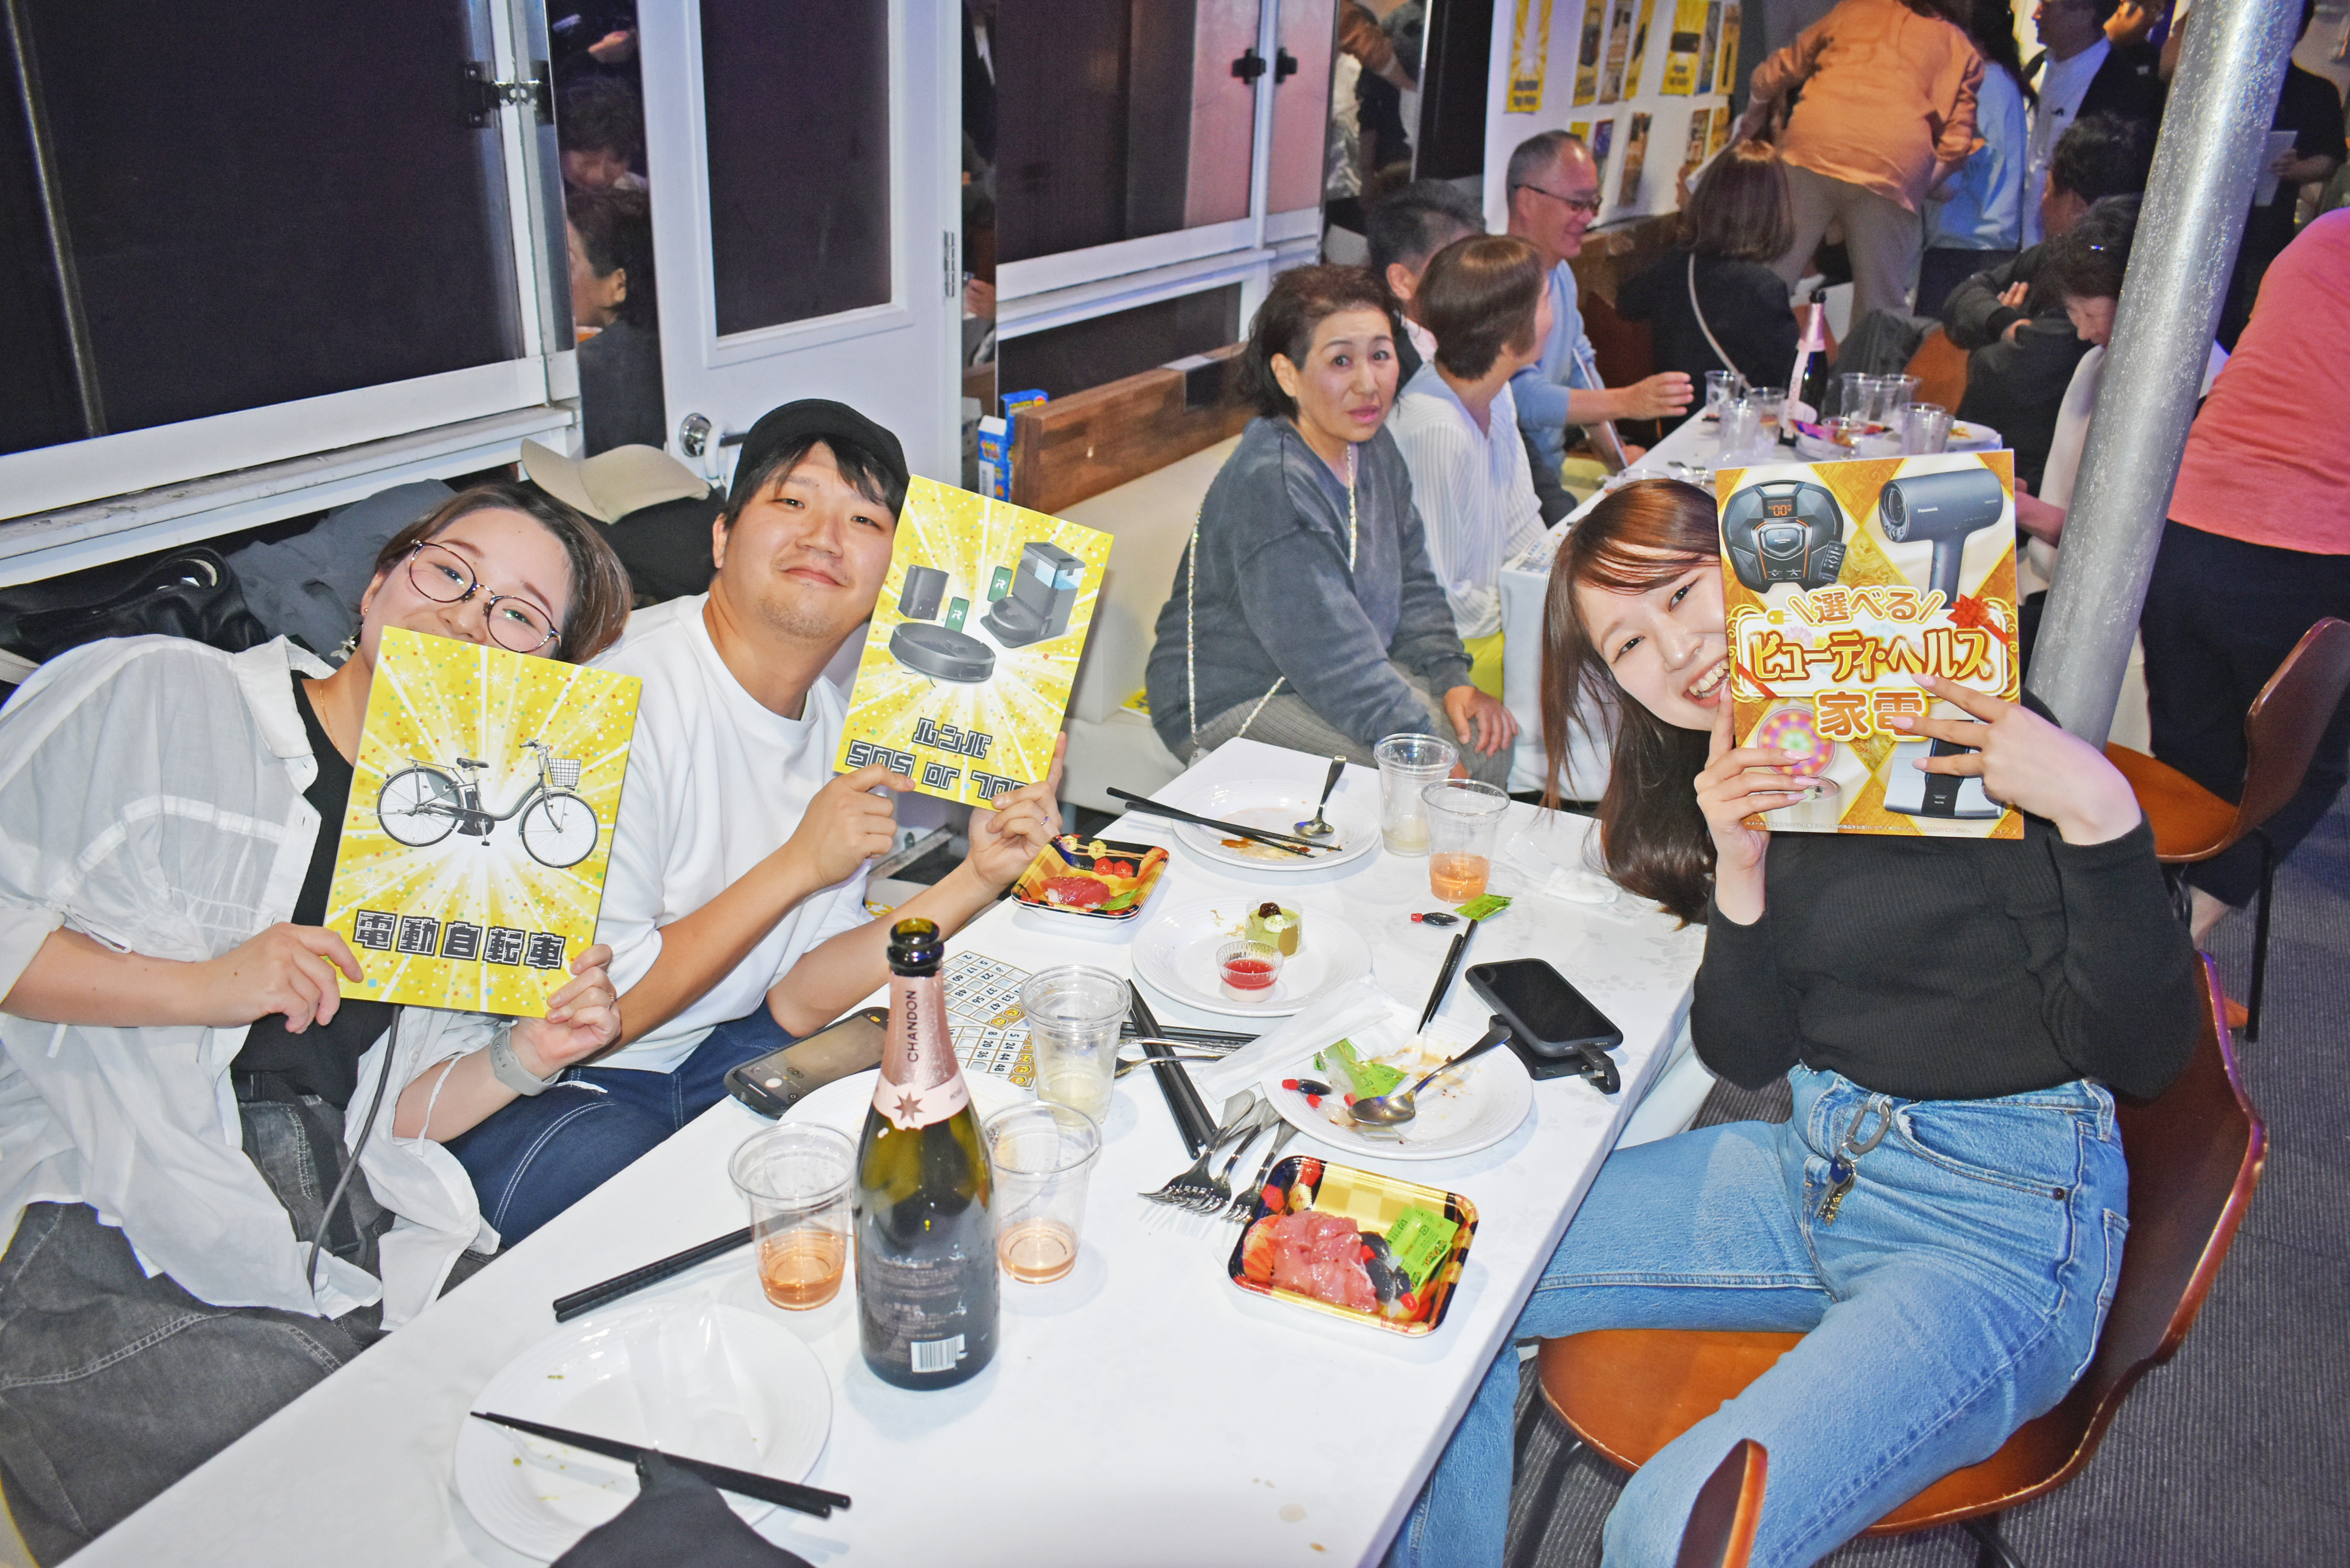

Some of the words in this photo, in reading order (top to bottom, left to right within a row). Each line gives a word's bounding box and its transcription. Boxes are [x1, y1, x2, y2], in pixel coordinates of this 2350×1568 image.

[1748, 628, 1995, 682] ビューティ・ヘルス
[912, 717, 993, 759] ルンバ
[1818, 690, 1924, 737] 家電
[921, 762, 960, 790] or
[971, 770, 1029, 801] 70
[352, 909, 566, 970] 電動自転車
[906, 990, 918, 1062] CHANDON
